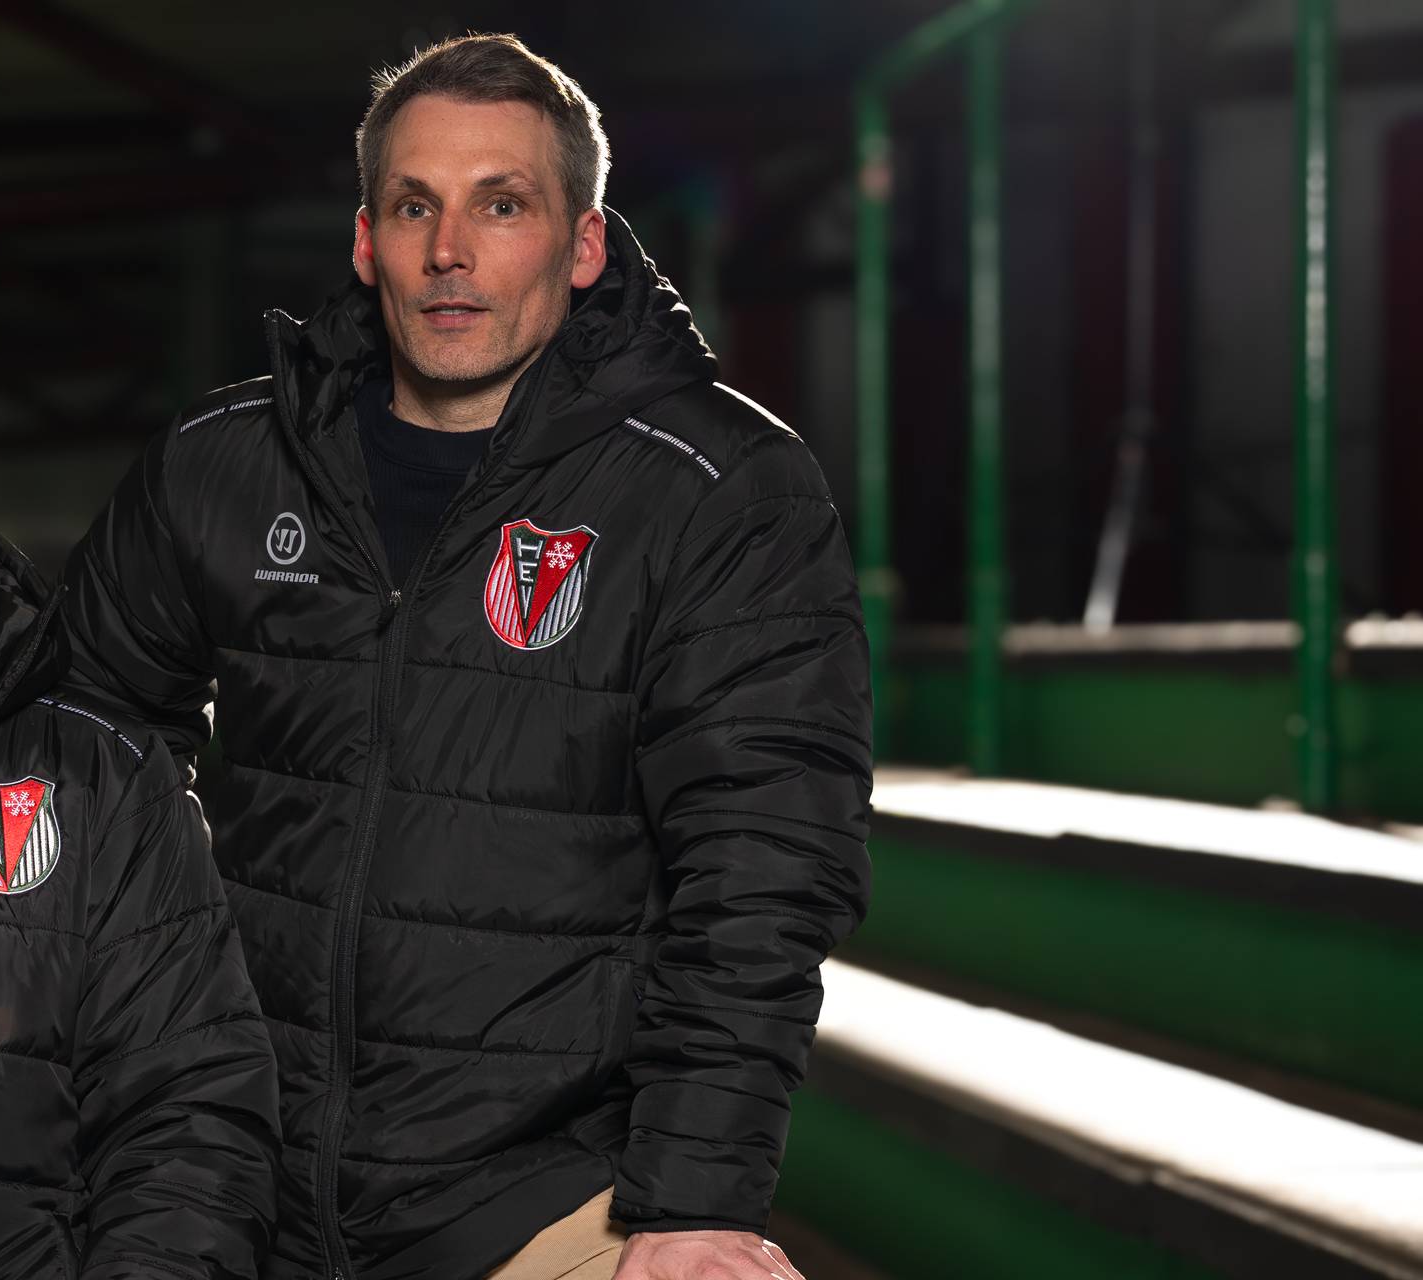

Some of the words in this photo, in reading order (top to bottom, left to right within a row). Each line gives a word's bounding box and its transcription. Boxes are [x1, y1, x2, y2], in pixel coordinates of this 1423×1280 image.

[651, 428, 696, 455] WARRIOR
[254, 569, 319, 584] WARRIOR
[516, 537, 544, 620] HEV
